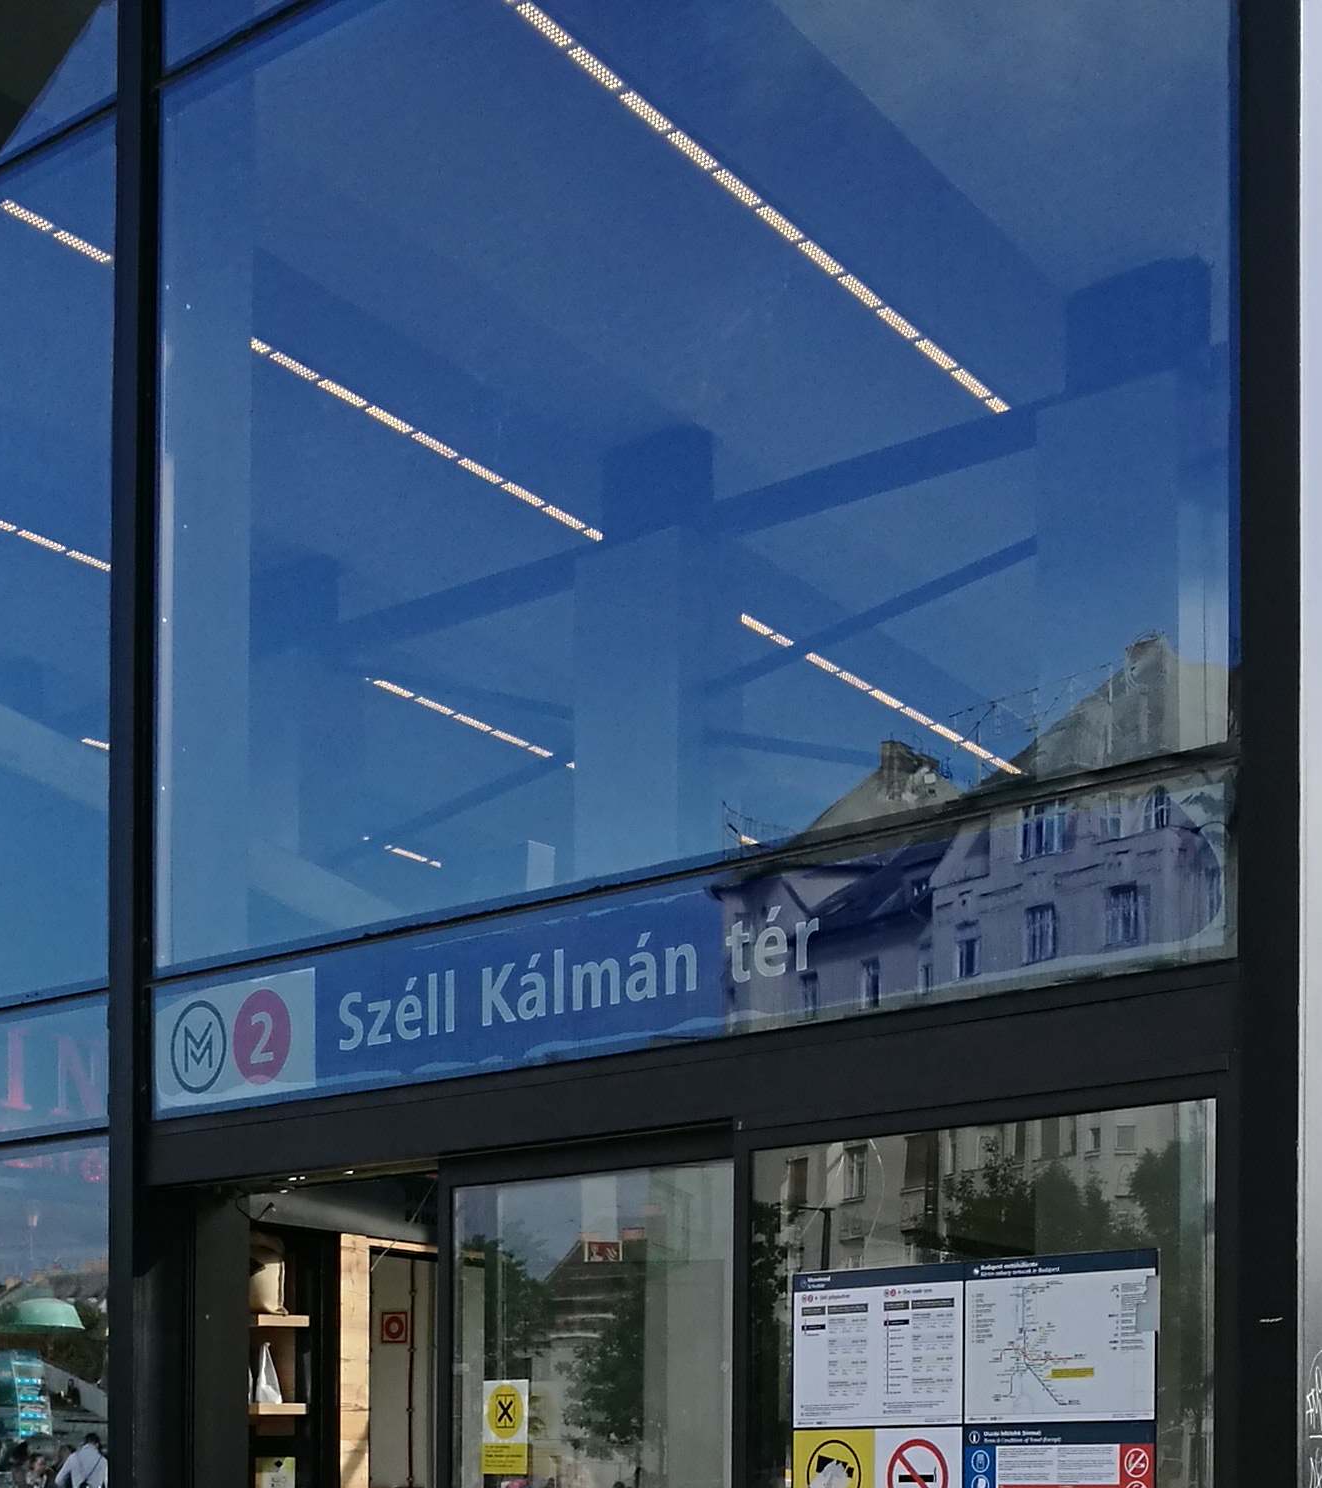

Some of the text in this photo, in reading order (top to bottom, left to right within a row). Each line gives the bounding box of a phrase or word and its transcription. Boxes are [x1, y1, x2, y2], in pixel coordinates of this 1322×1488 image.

[248, 1012, 274, 1064] 2
[339, 968, 456, 1051] Széll
[482, 932, 698, 1026] Kálmán
[726, 905, 819, 984] tér
